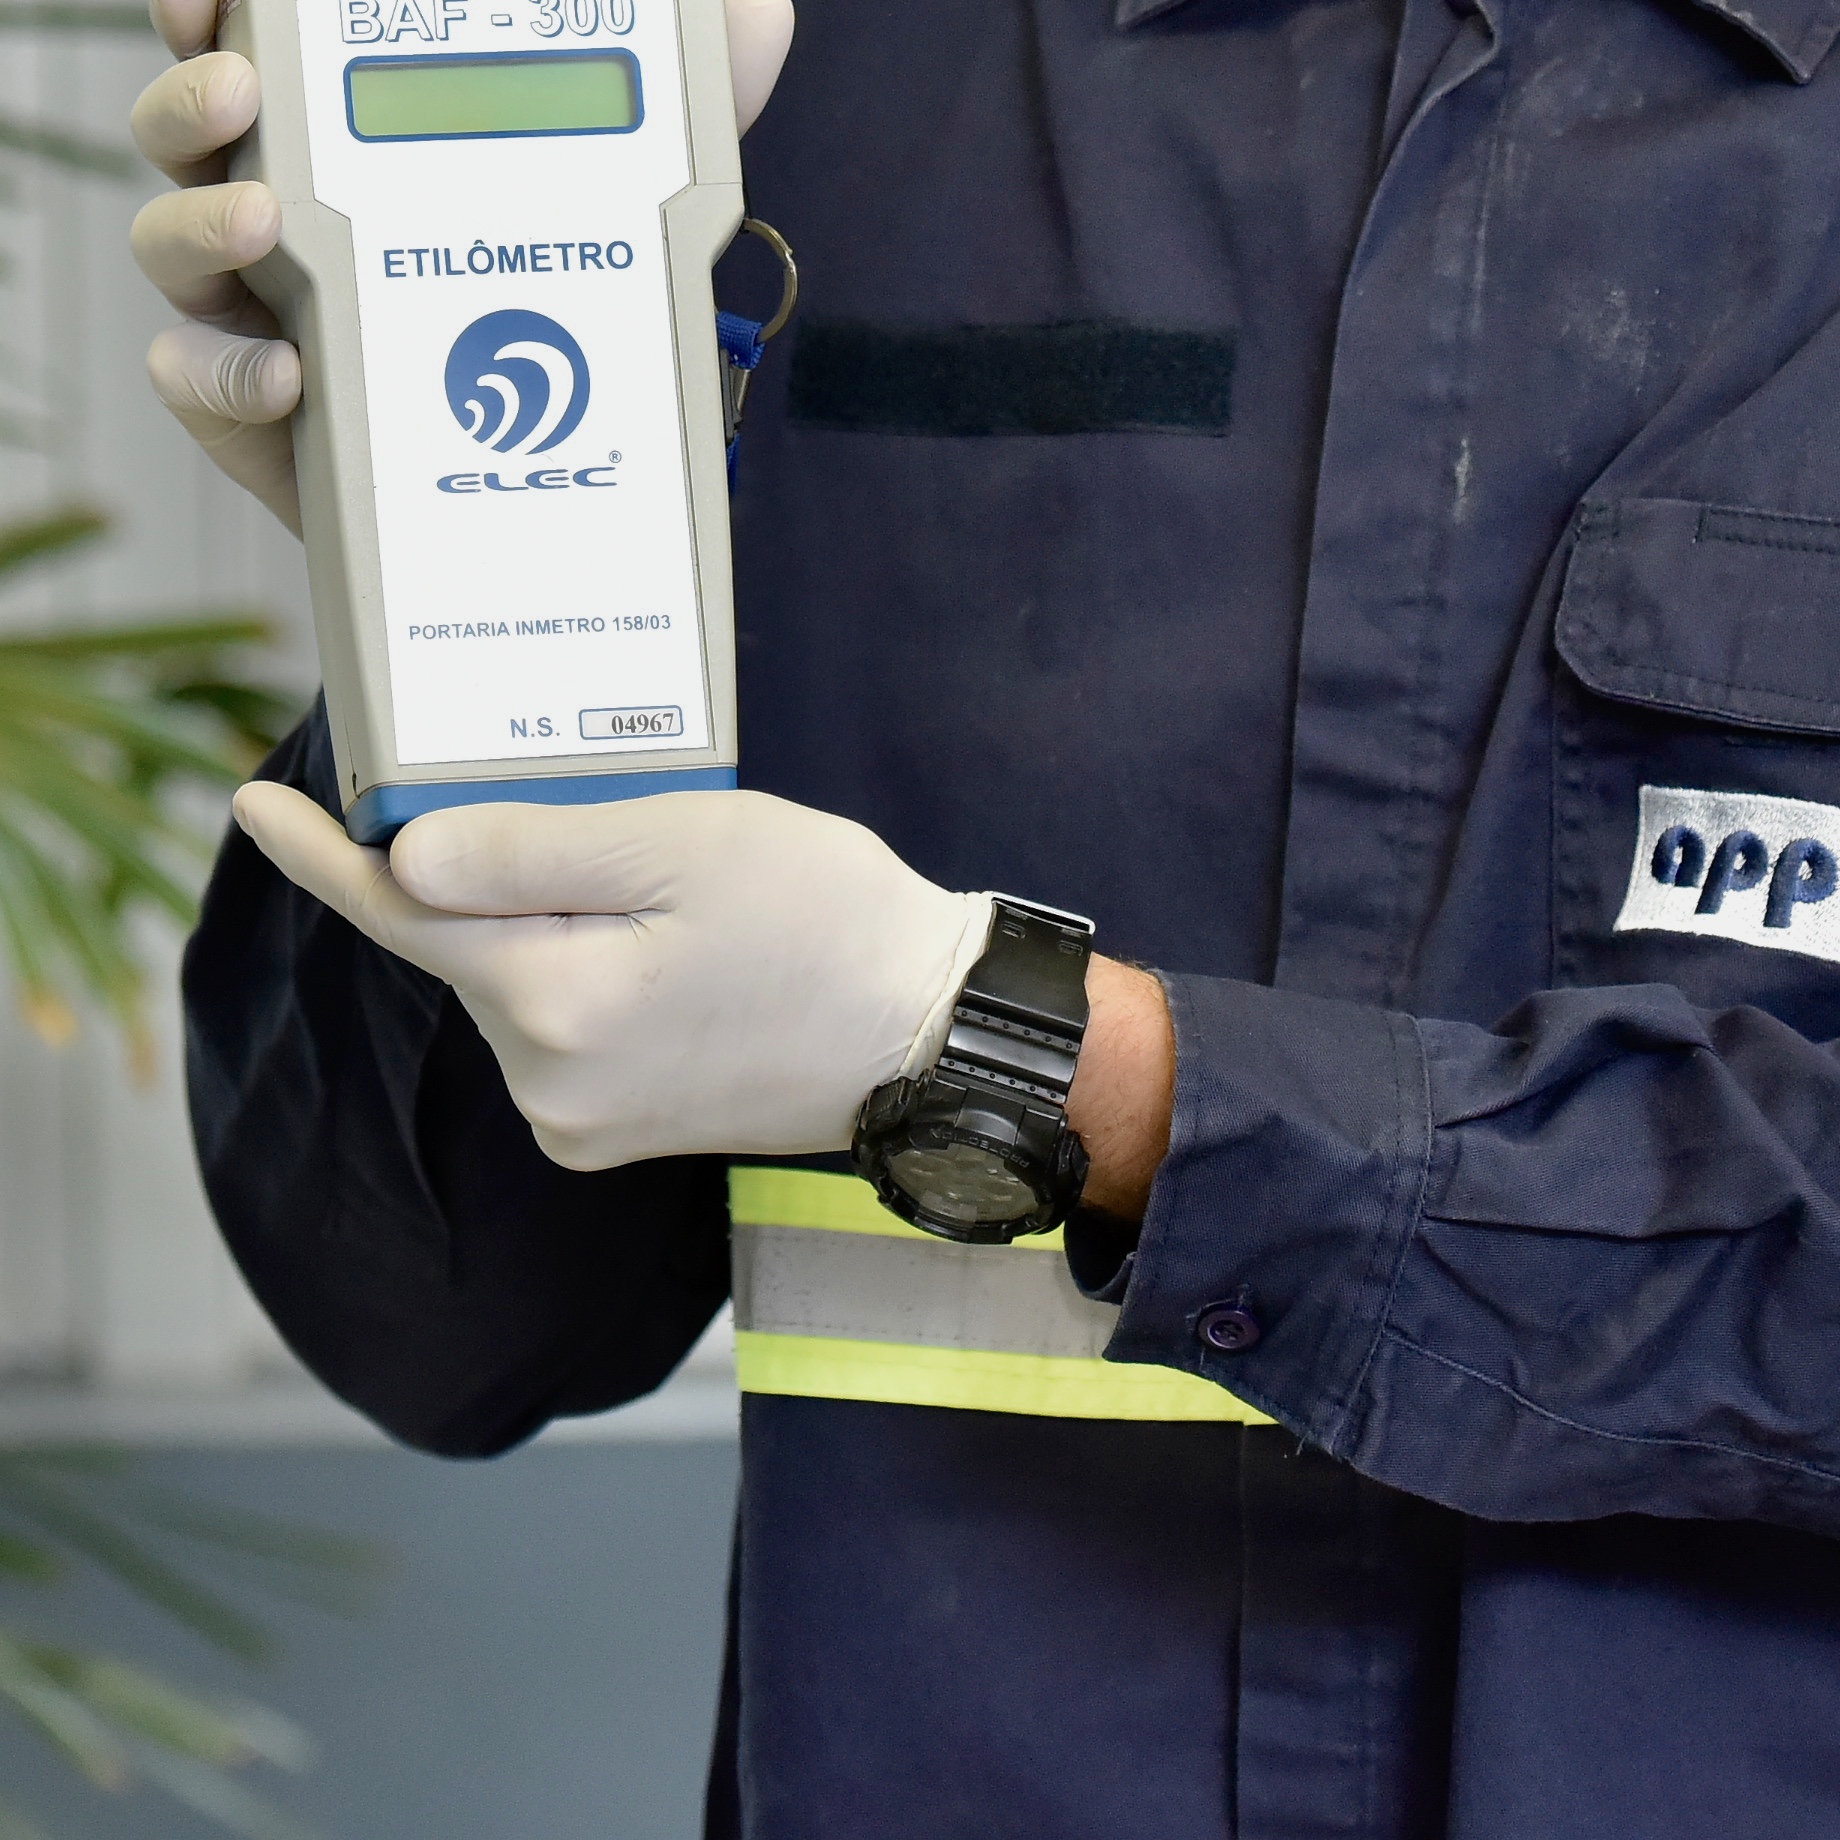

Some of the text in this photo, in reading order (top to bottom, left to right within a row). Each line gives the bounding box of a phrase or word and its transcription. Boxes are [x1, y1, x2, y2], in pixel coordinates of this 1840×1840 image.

[383, 238, 634, 279] ETILÔMETRO
[436, 466, 618, 494] ELEC
[408, 614, 672, 641] PORTARIA INMETRO 158/03
[509, 712, 675, 738] N.S. 04967
